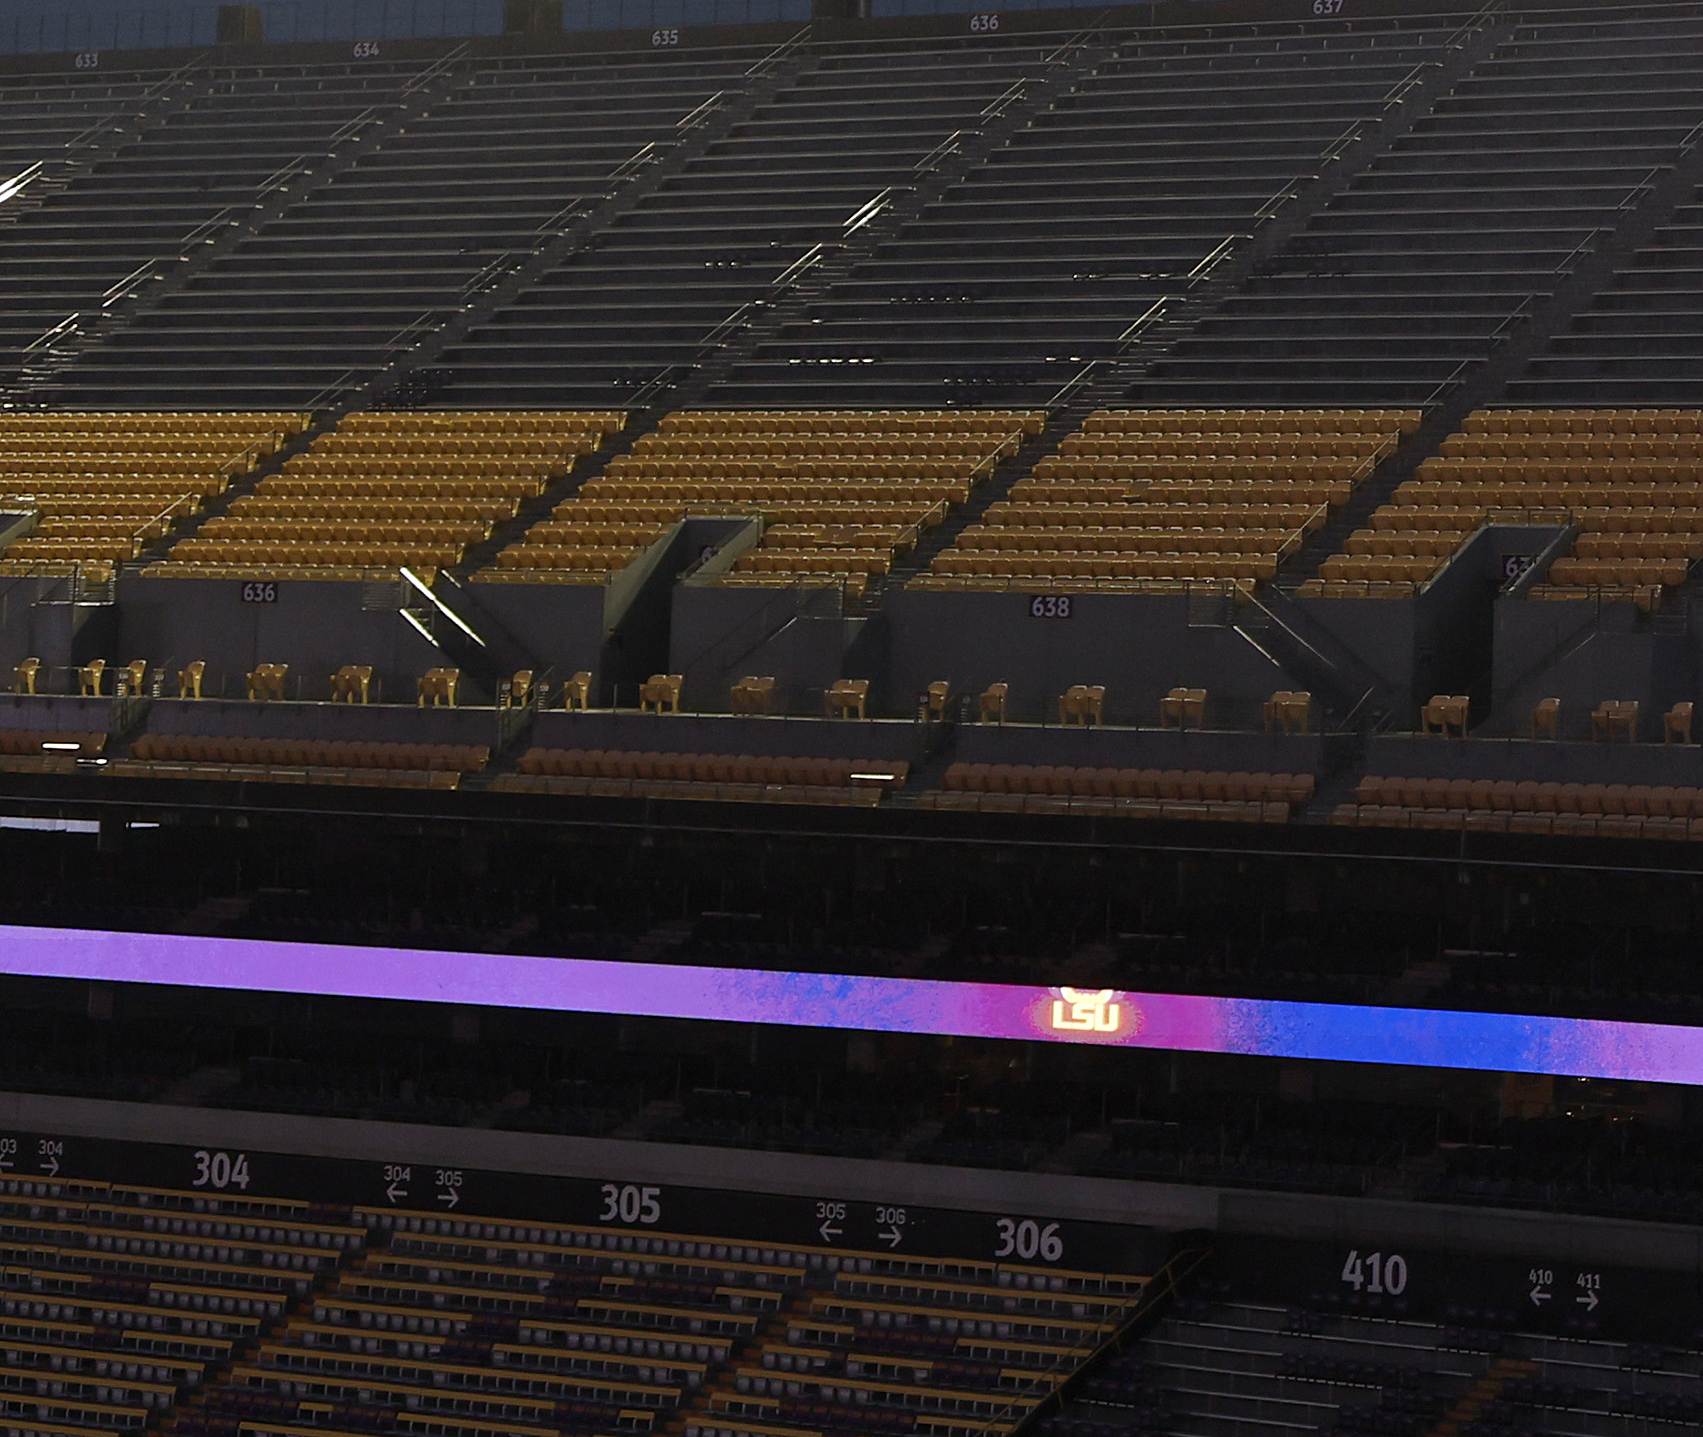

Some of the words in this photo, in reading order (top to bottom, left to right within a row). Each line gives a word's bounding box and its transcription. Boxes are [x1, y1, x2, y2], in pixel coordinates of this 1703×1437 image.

[970, 14, 999, 32] 636
[652, 29, 680, 47] 635
[353, 42, 380, 60] 634
[75, 53, 99, 69] 633
[243, 583, 275, 603] 636
[1032, 596, 1070, 618] 638
[1052, 1000, 1120, 1032] LSU
[0, 1138, 17, 1154] 03
[38, 1139, 63, 1156] 304
[192, 1150, 251, 1190] 304
[383, 1165, 411, 1182] 304
[435, 1169, 463, 1187] 305
[599, 1183, 661, 1224] 305
[816, 1202, 846, 1220] 305
[875, 1206, 906, 1225] 306
[994, 1218, 1064, 1262] 306
[1341, 1250, 1408, 1296] 410
[1528, 1268, 1553, 1286] 410
[1576, 1273, 1601, 1290] 411
